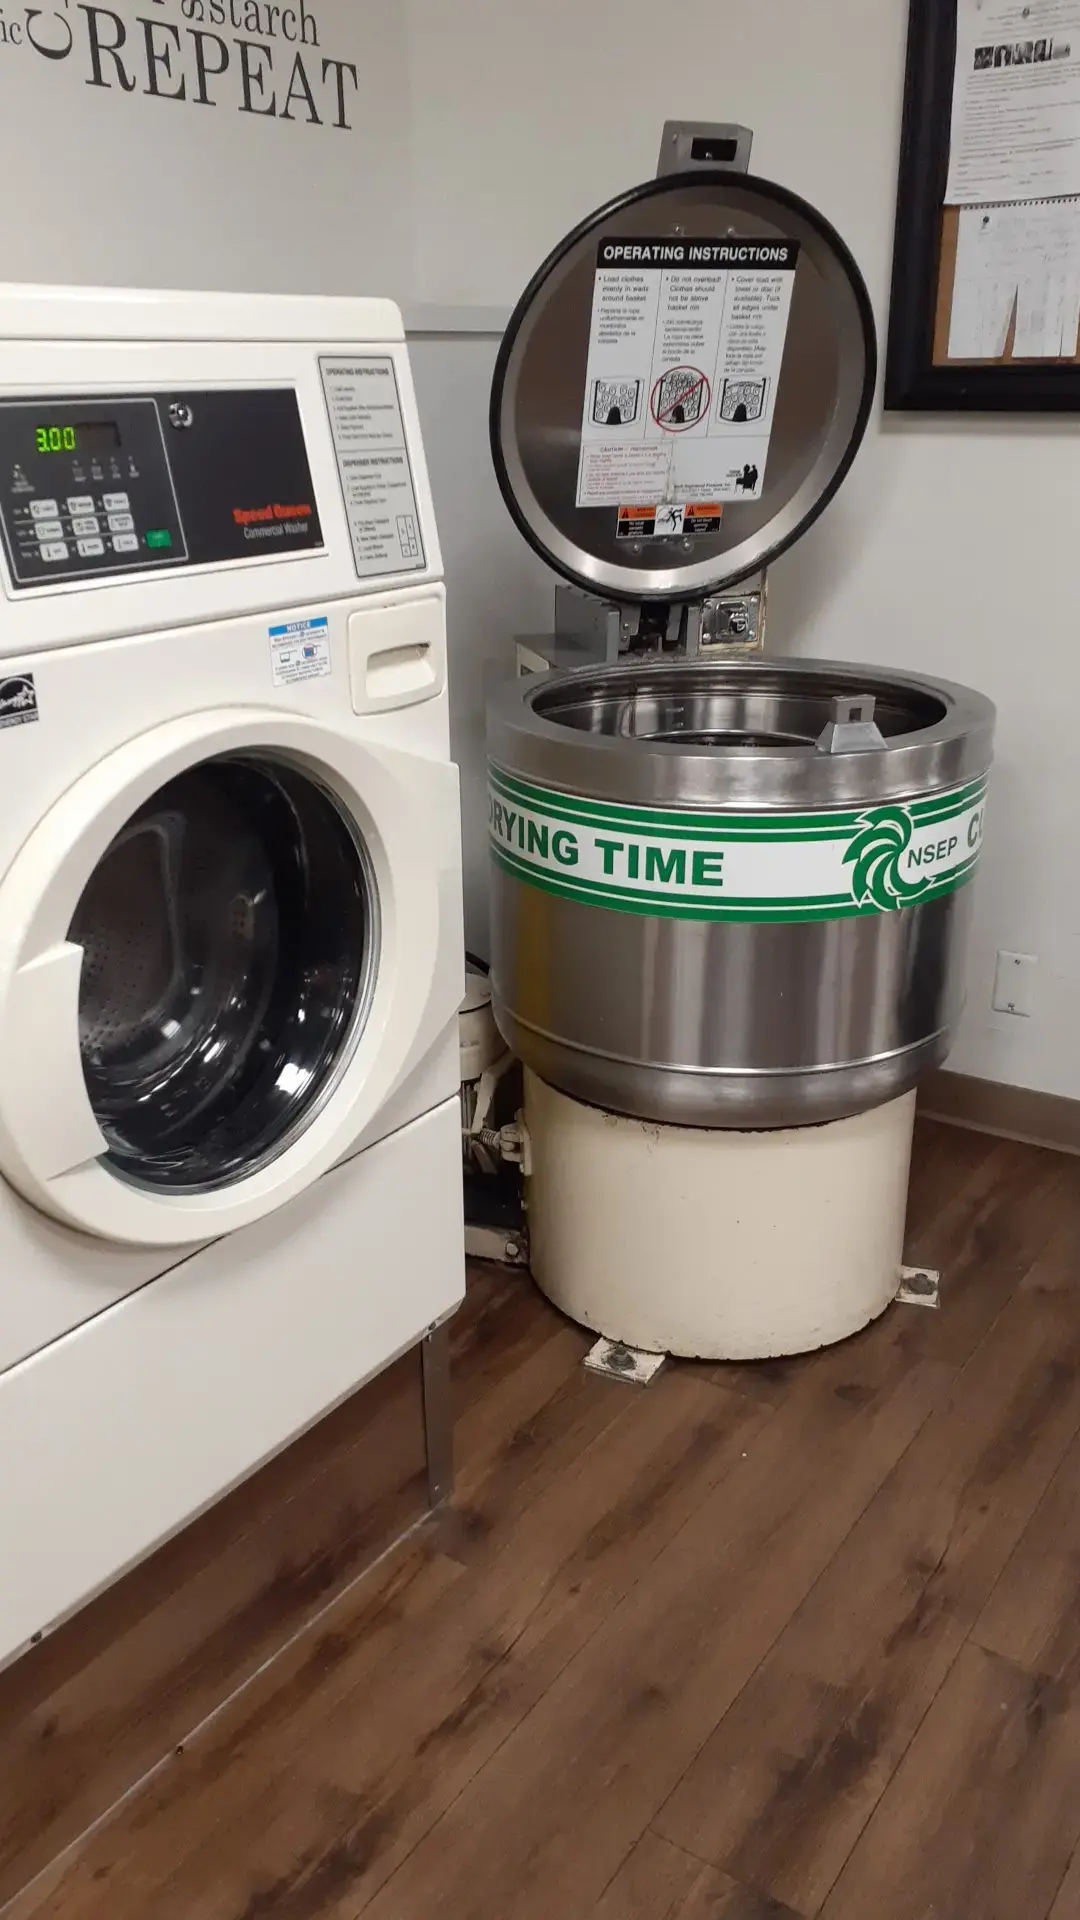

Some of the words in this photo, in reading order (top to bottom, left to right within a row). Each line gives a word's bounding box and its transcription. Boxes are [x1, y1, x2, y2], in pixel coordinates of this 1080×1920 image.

[77, 3, 359, 130] REPEAT
[603, 246, 684, 261] OPERATING
[689, 247, 788, 262] INSTRUCTIONS
[621, 275, 644, 283] clothes
[244, 523, 284, 539] Commercial
[284, 521, 308, 535] Washer
[594, 838, 724, 887] TIME
[907, 836, 958, 868] NSEP
